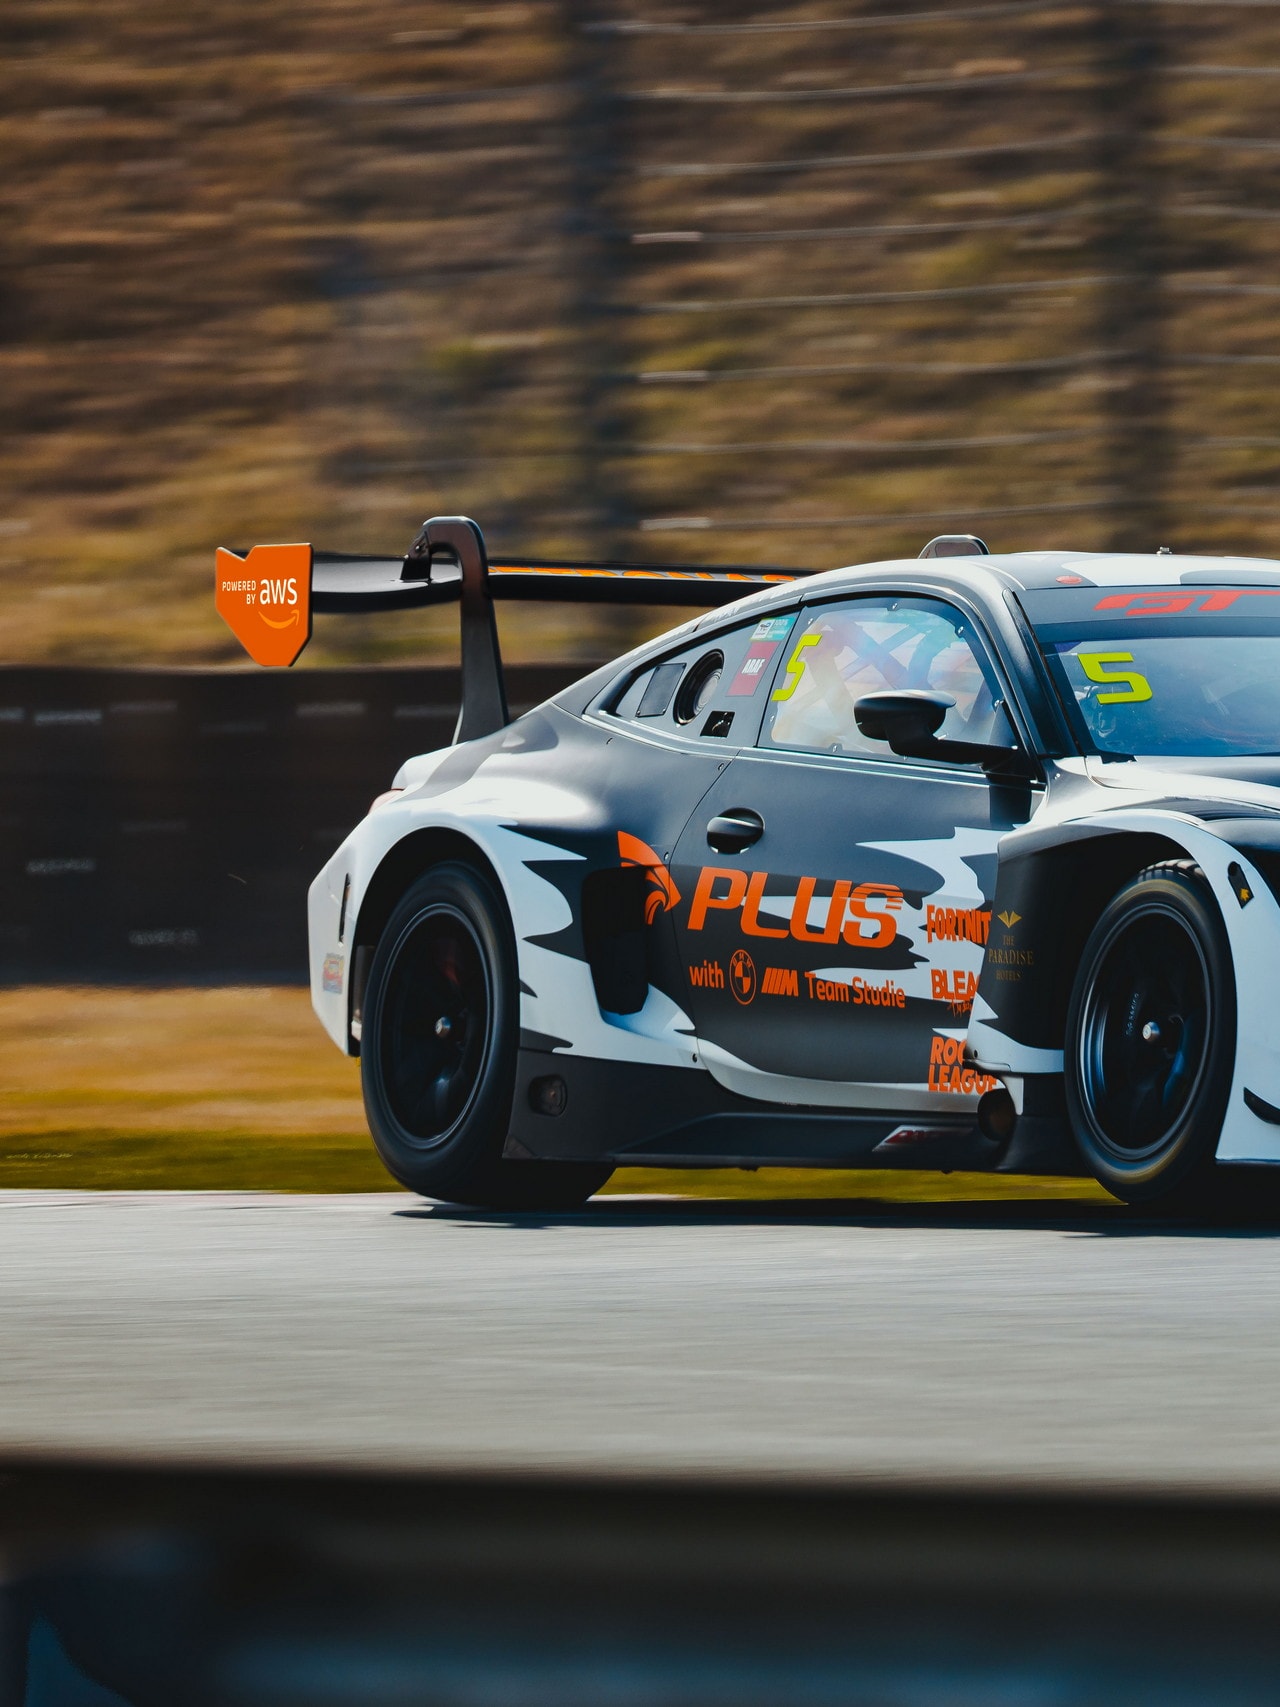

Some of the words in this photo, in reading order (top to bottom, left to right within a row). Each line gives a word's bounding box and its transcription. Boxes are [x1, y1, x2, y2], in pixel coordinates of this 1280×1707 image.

[222, 580, 256, 592] POWERED
[246, 594, 256, 605] BY
[259, 578, 298, 605] aws
[771, 633, 823, 702] 5
[1077, 651, 1154, 706] 5
[687, 865, 904, 949] PLUS
[1003, 935, 1015, 946] THE
[988, 948, 1035, 966] PARADISE
[689, 959, 725, 989] with
[804, 971, 850, 1003] Team
[852, 976, 906, 1008] Studie
